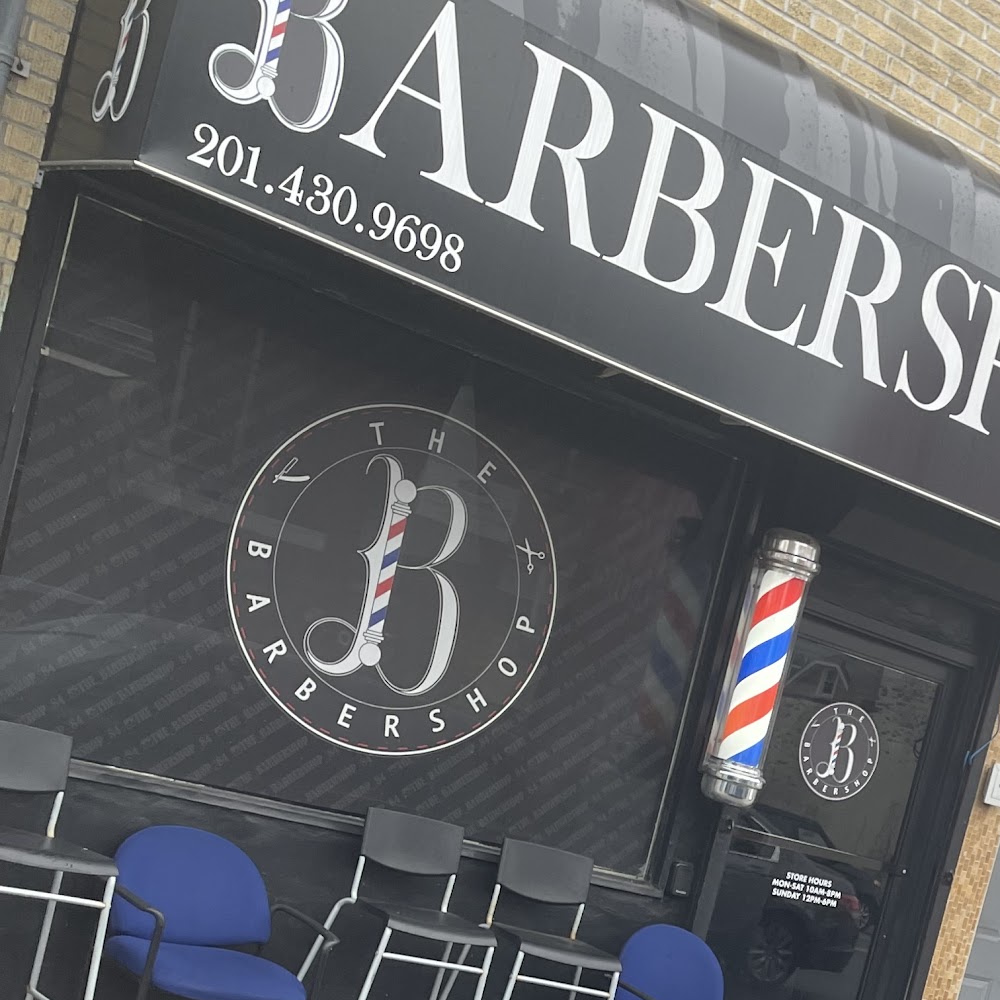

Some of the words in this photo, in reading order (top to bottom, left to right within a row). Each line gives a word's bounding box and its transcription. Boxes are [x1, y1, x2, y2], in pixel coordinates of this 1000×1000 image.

[186, 122, 465, 273] 201.430.9698
[368, 421, 497, 485] THE
[246, 539, 536, 738] BARBERSHOP
[802, 742, 873, 796] BARBERSHOP
[772, 878, 805, 892] MON-SAT
[805, 885, 842, 899] 10AM-8PM
[772, 887, 801, 900] SUNDAY
[802, 893, 837, 908] 12PM-6PM
[786, 871, 808, 883] STORE
[808, 876, 833, 888] HOURS
